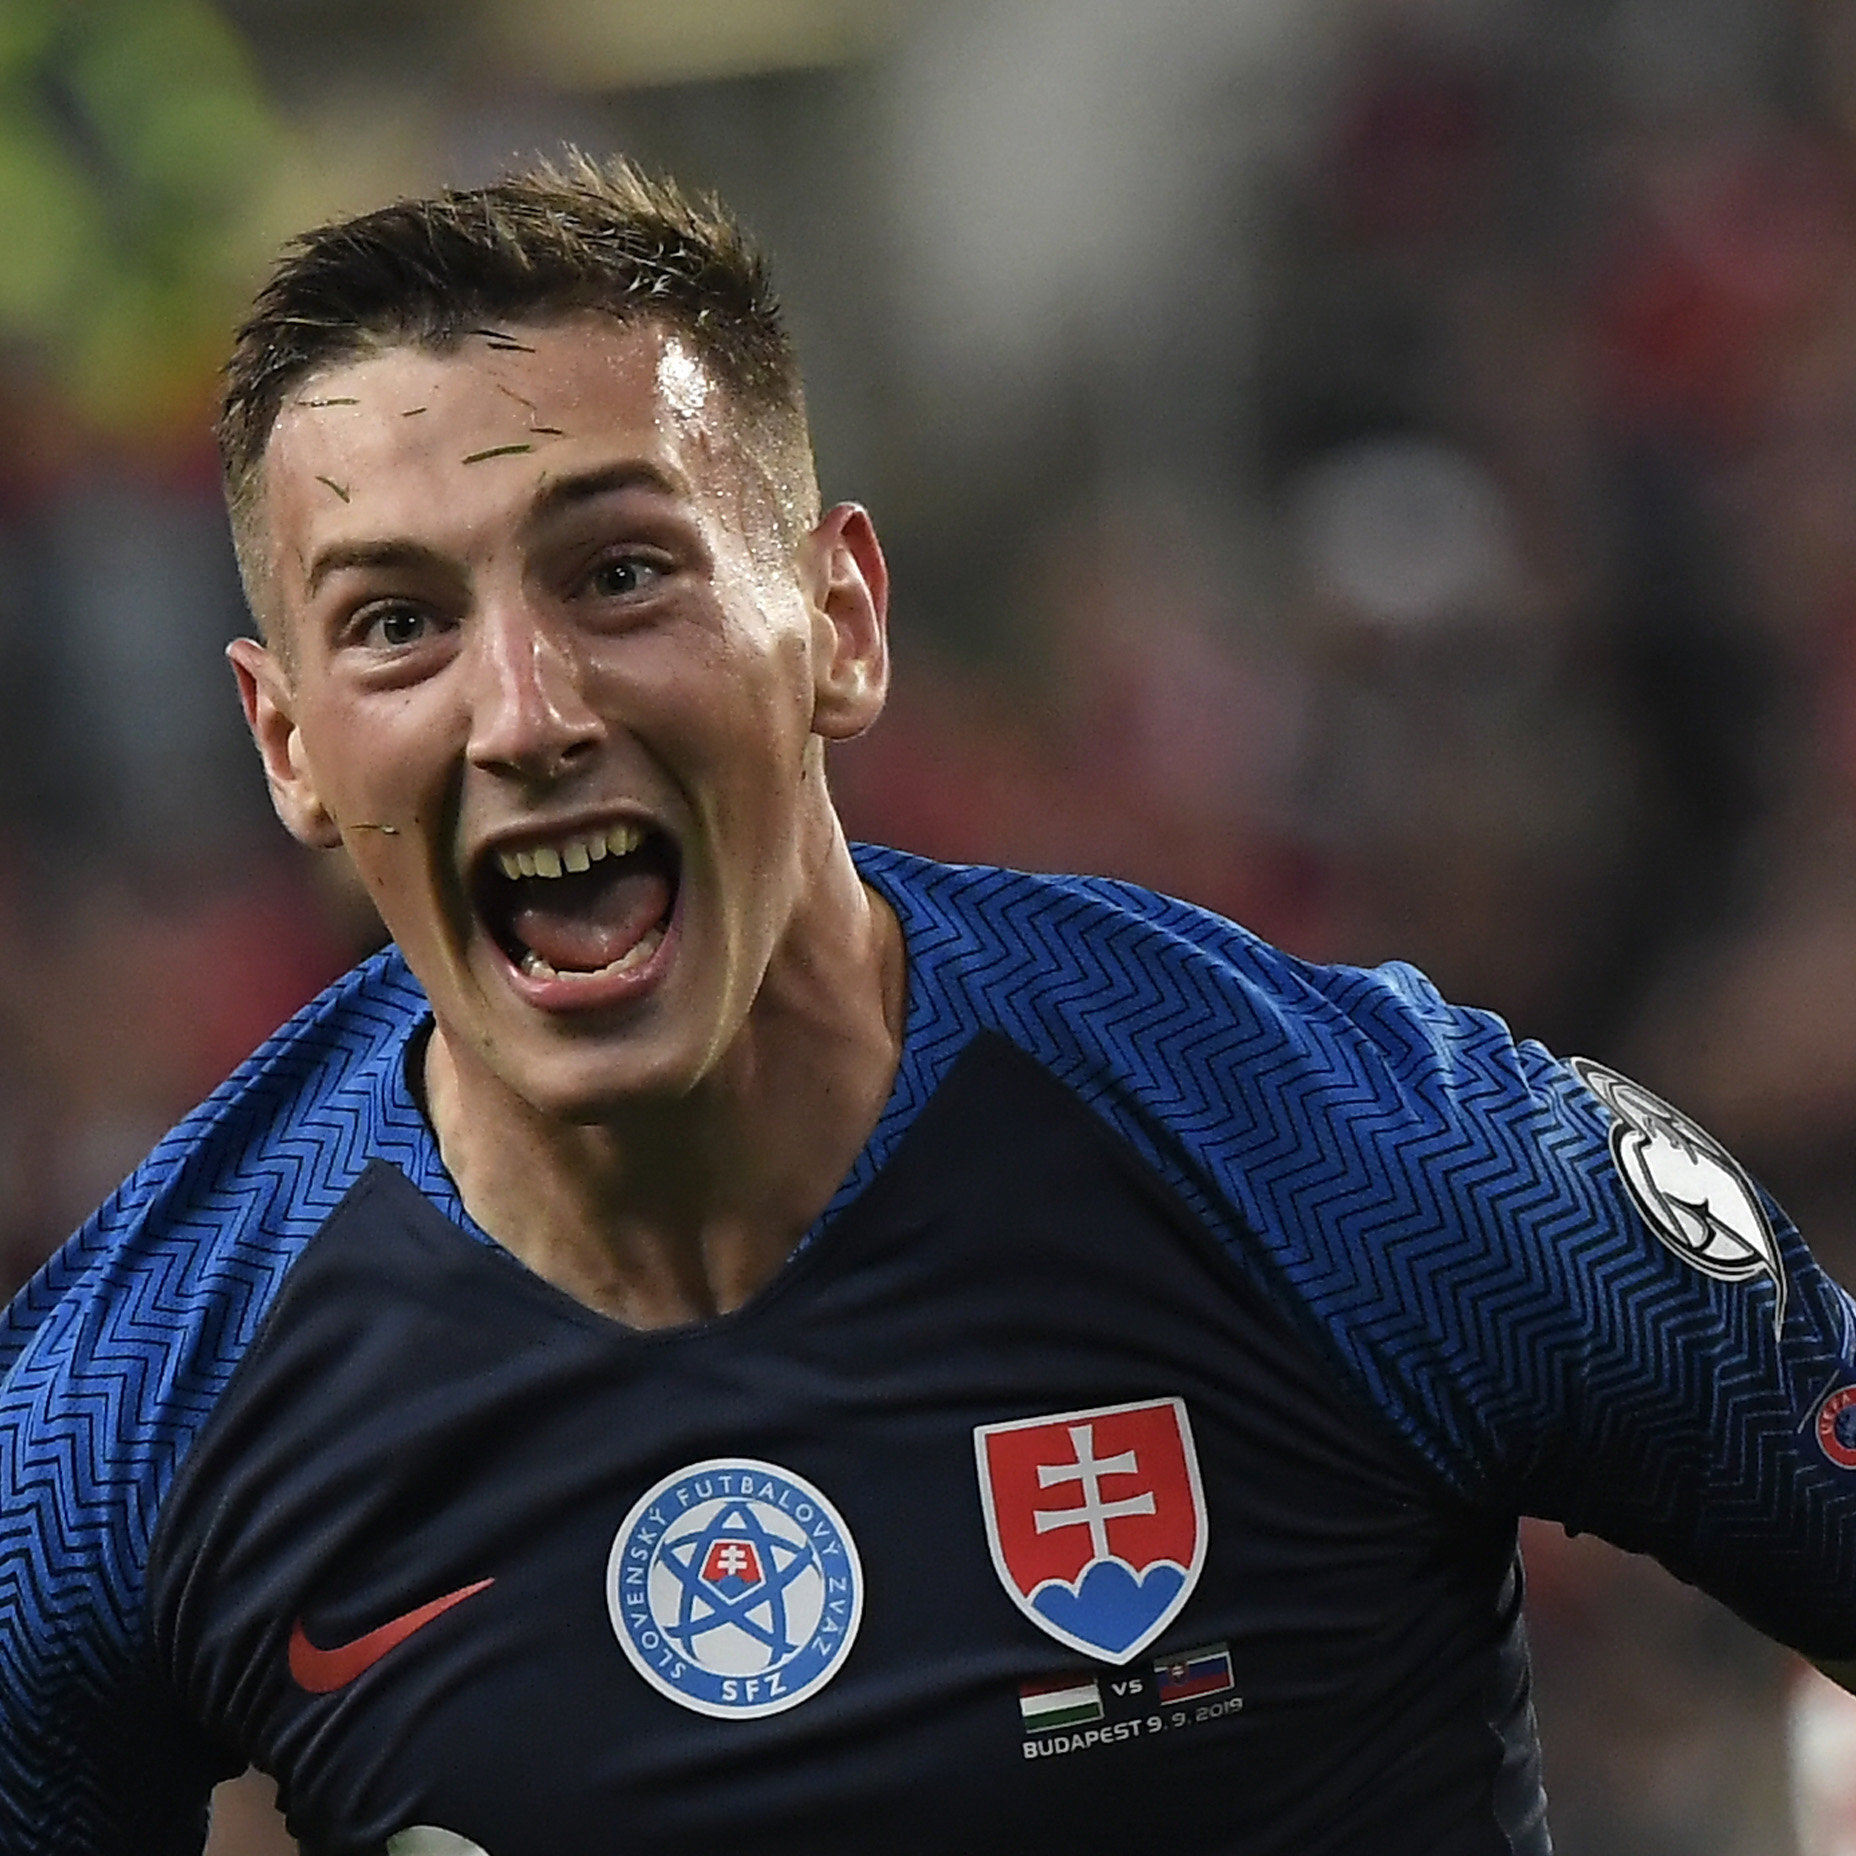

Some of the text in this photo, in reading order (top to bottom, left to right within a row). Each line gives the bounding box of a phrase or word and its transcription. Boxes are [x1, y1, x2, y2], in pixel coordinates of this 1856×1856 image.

[721, 1673, 787, 1703] SFZ
[1021, 1719, 1143, 1760] BUDAPEST
[1195, 1696, 1244, 1723] 2019
